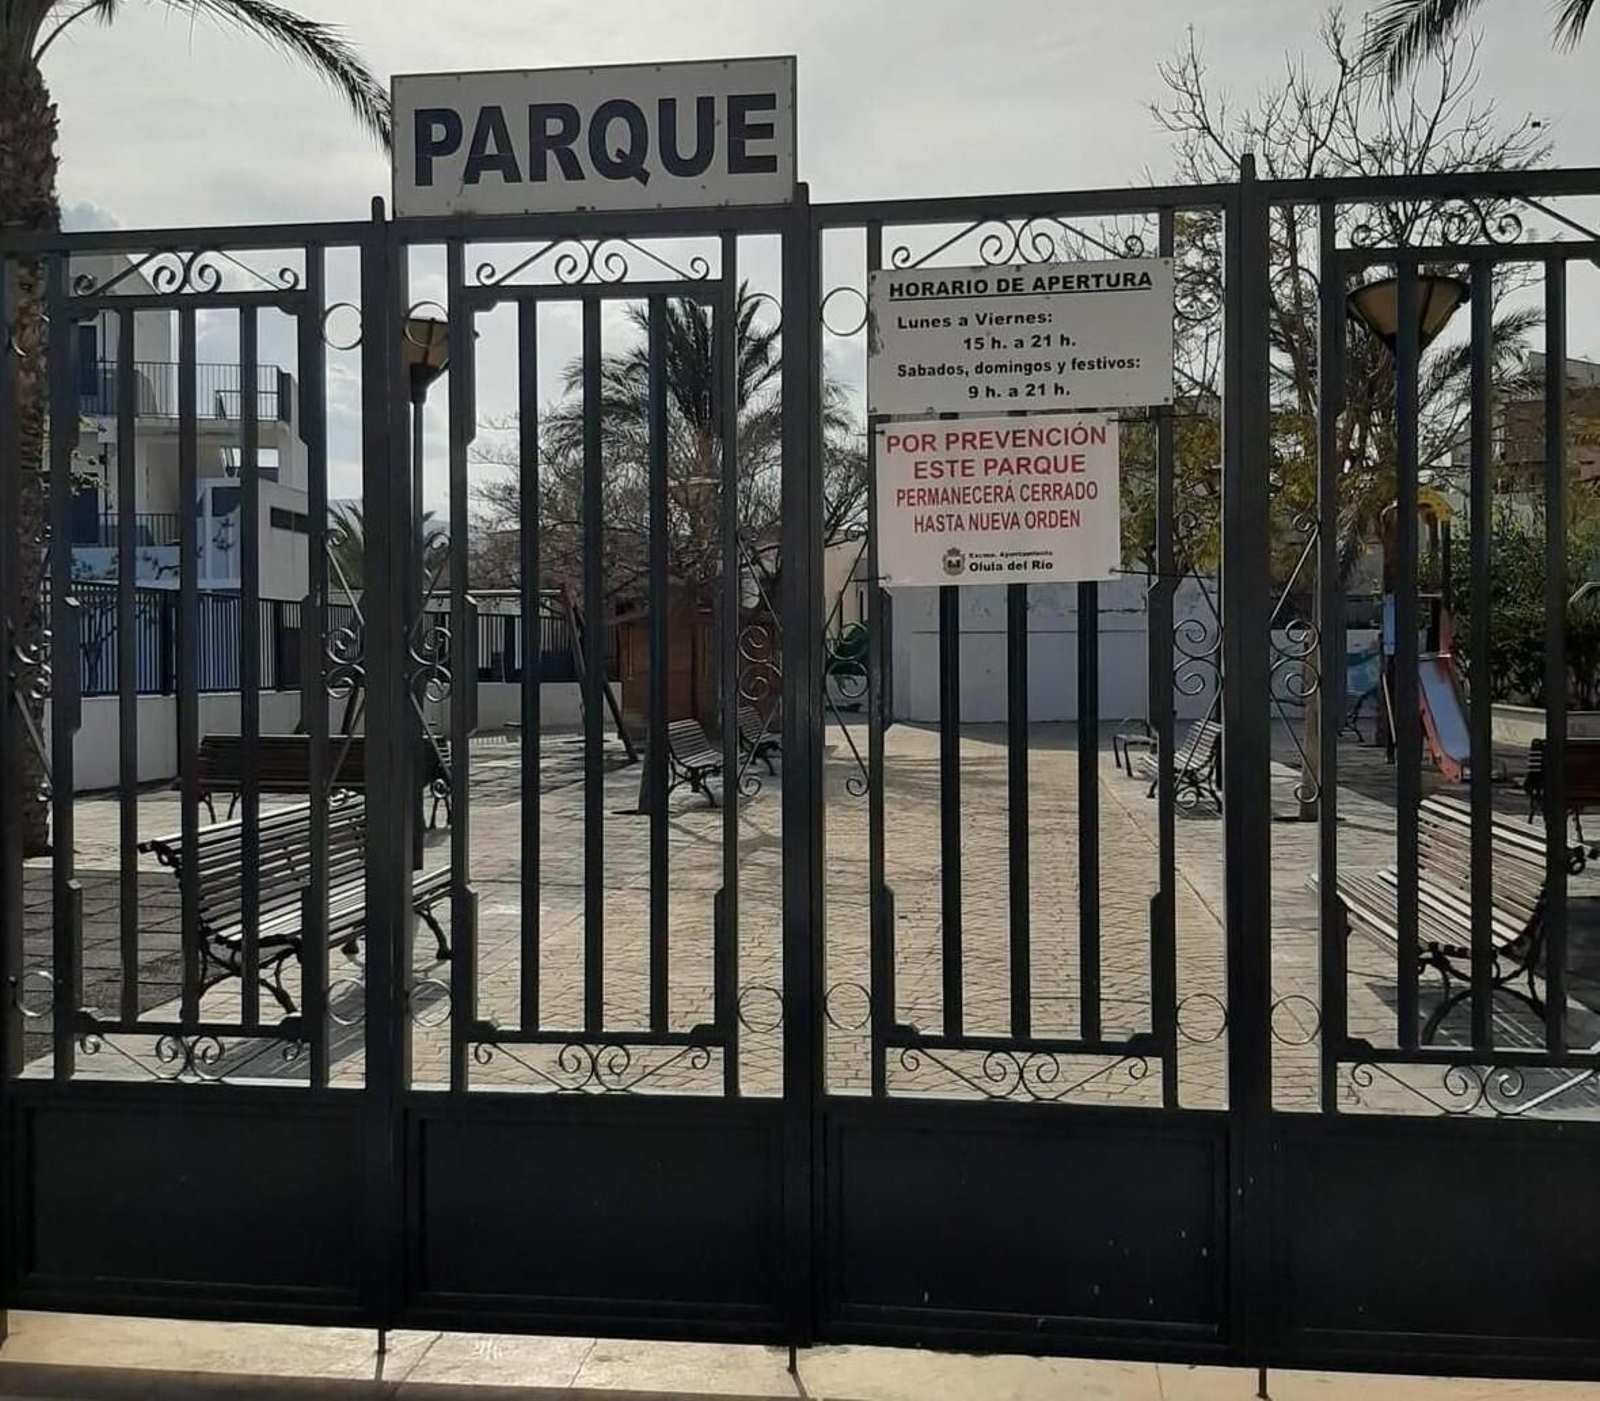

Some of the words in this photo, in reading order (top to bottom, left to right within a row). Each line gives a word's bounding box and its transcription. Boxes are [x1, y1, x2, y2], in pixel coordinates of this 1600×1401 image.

[414, 92, 778, 186] PARQUE
[889, 279, 989, 298] HORARIO
[996, 277, 1026, 293] DE
[1031, 271, 1152, 290] APERTURA
[898, 317, 951, 329] Lunes
[958, 316, 969, 327] a
[976, 313, 1052, 325] Viernes:
[963, 337, 985, 351] 15
[991, 336, 1008, 350] h.
[1014, 338, 1024, 349] a
[1031, 334, 1051, 348] 21
[1060, 333, 1076, 347] h.
[898, 363, 968, 377] Sabados,
[975, 361, 1051, 375] domingos
[1057, 361, 1066, 375] y
[1072, 357, 1140, 370] festivos:
[968, 385, 979, 399] 9
[985, 385, 1001, 398] h.
[1008, 387, 1019, 398] a
[1025, 383, 1046, 397] 21
[1054, 382, 1070, 396] h.
[887, 434, 936, 453] POR
[945, 422, 1107, 450] PREVENCIÓN
[915, 459, 974, 479] ESTE
[985, 455, 1085, 476] PARQUE
[897, 480, 1015, 506] PERMANECERÁ
[1020, 482, 1097, 502] CERRADO
[915, 514, 964, 532] HASTA
[969, 512, 1020, 530] NUEVA
[1025, 510, 1079, 529] ORDEN
[968, 561, 1003, 572] Olula
[1007, 560, 1028, 571] del
